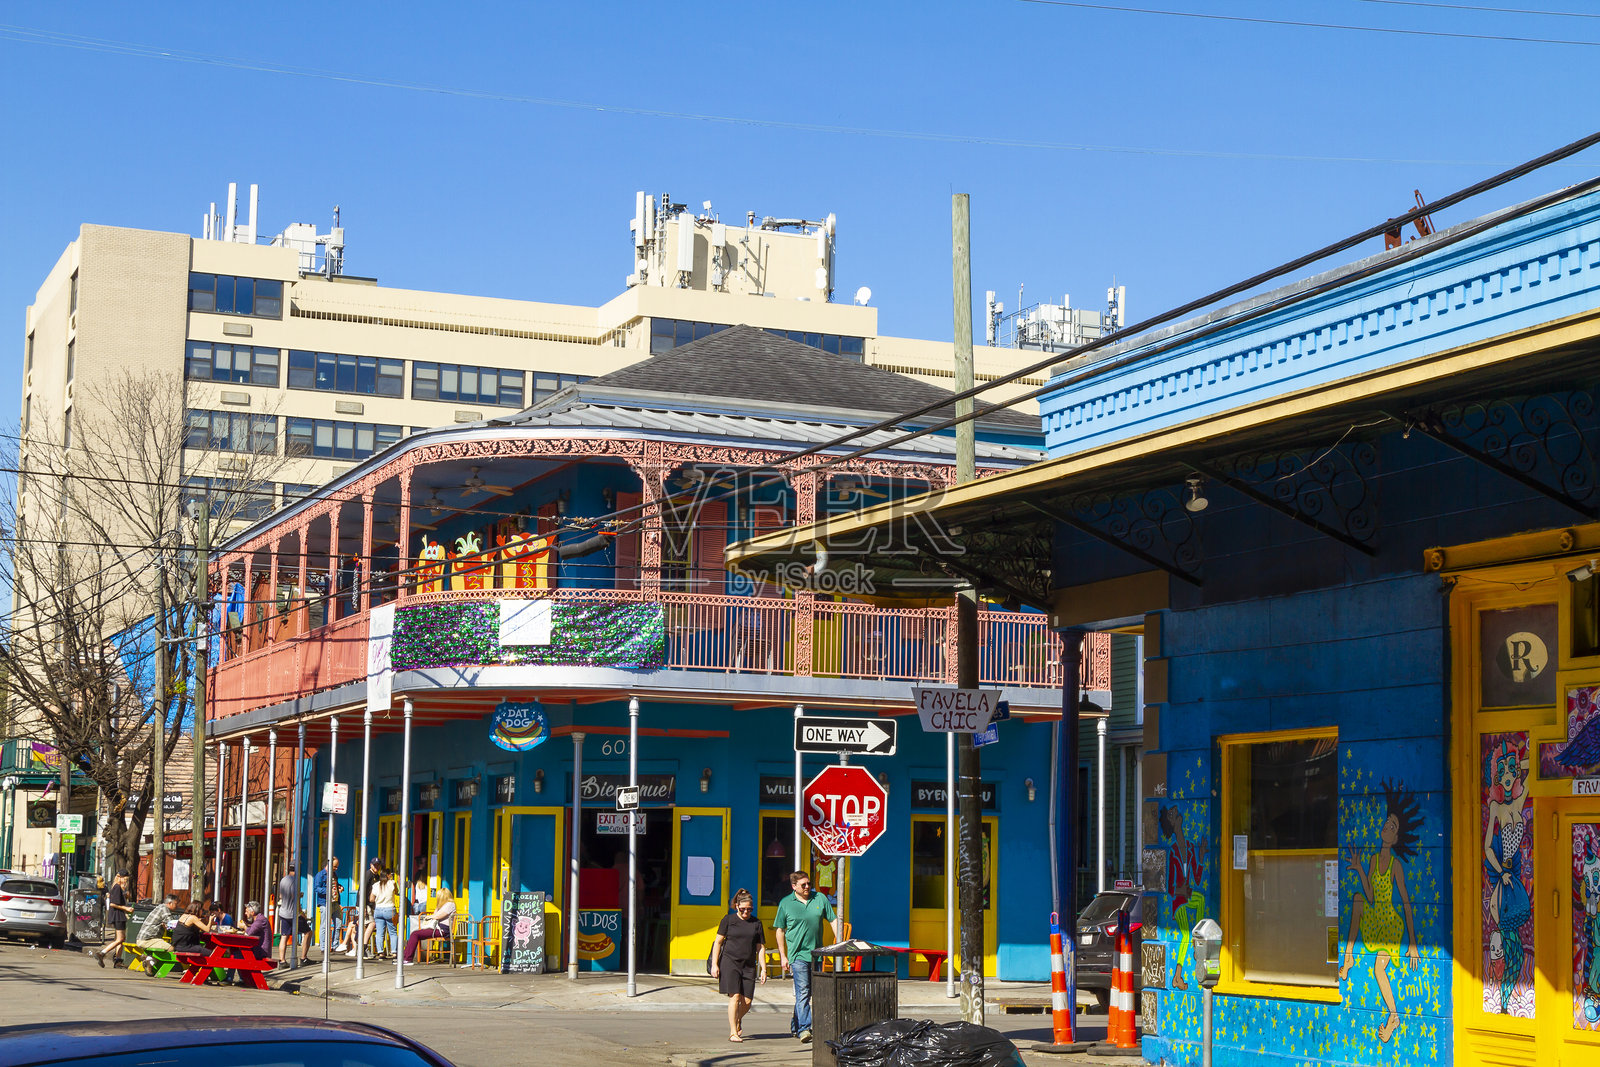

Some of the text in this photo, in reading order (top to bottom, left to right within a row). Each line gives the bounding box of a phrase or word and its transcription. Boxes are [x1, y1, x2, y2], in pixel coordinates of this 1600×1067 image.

[920, 690, 989, 712] FAVELA
[507, 708, 529, 718] DAT
[930, 710, 978, 730] CHIC
[505, 718, 533, 728] DOG
[806, 728, 865, 743] ONE WAY
[1577, 780, 1600, 794] FAV
[808, 793, 881, 826] STOP
[599, 814, 617, 824] EXIT
[1397, 976, 1431, 1004] Emily
[1180, 994, 1197, 1013] AD
